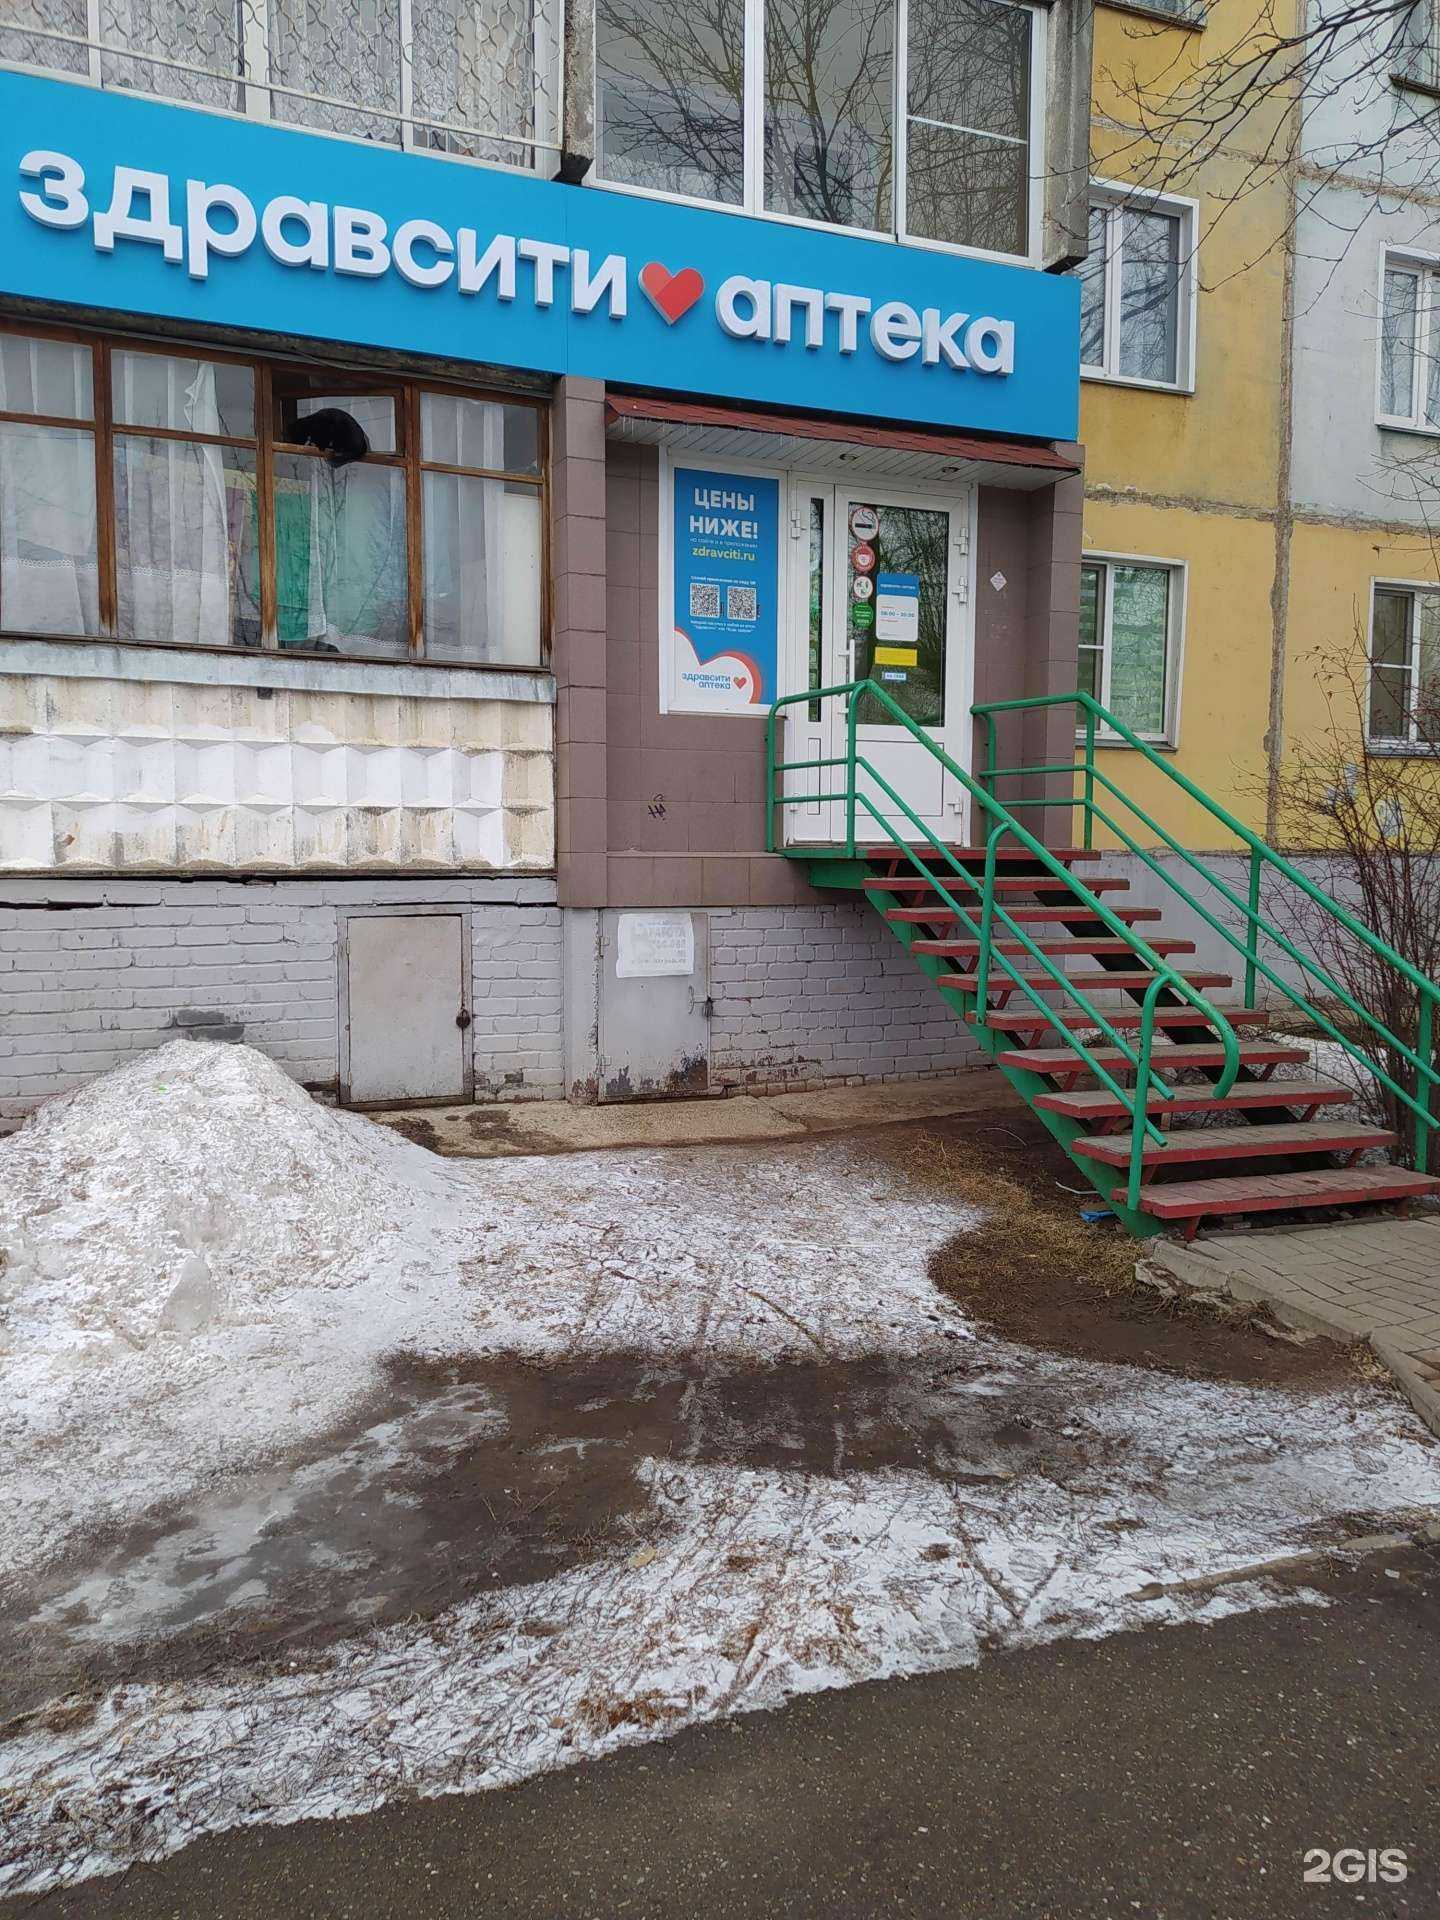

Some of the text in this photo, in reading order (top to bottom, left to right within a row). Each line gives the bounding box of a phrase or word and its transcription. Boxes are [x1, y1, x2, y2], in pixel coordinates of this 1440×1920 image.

[18, 149, 1015, 376] здравсити аптека
[694, 487, 755, 512] ЦЕНЫ
[689, 515, 759, 540] НИЖЕ!
[692, 546, 756, 561] zdravciti.ru
[681, 672, 731, 682] здравсити
[699, 681, 731, 690] аптека
